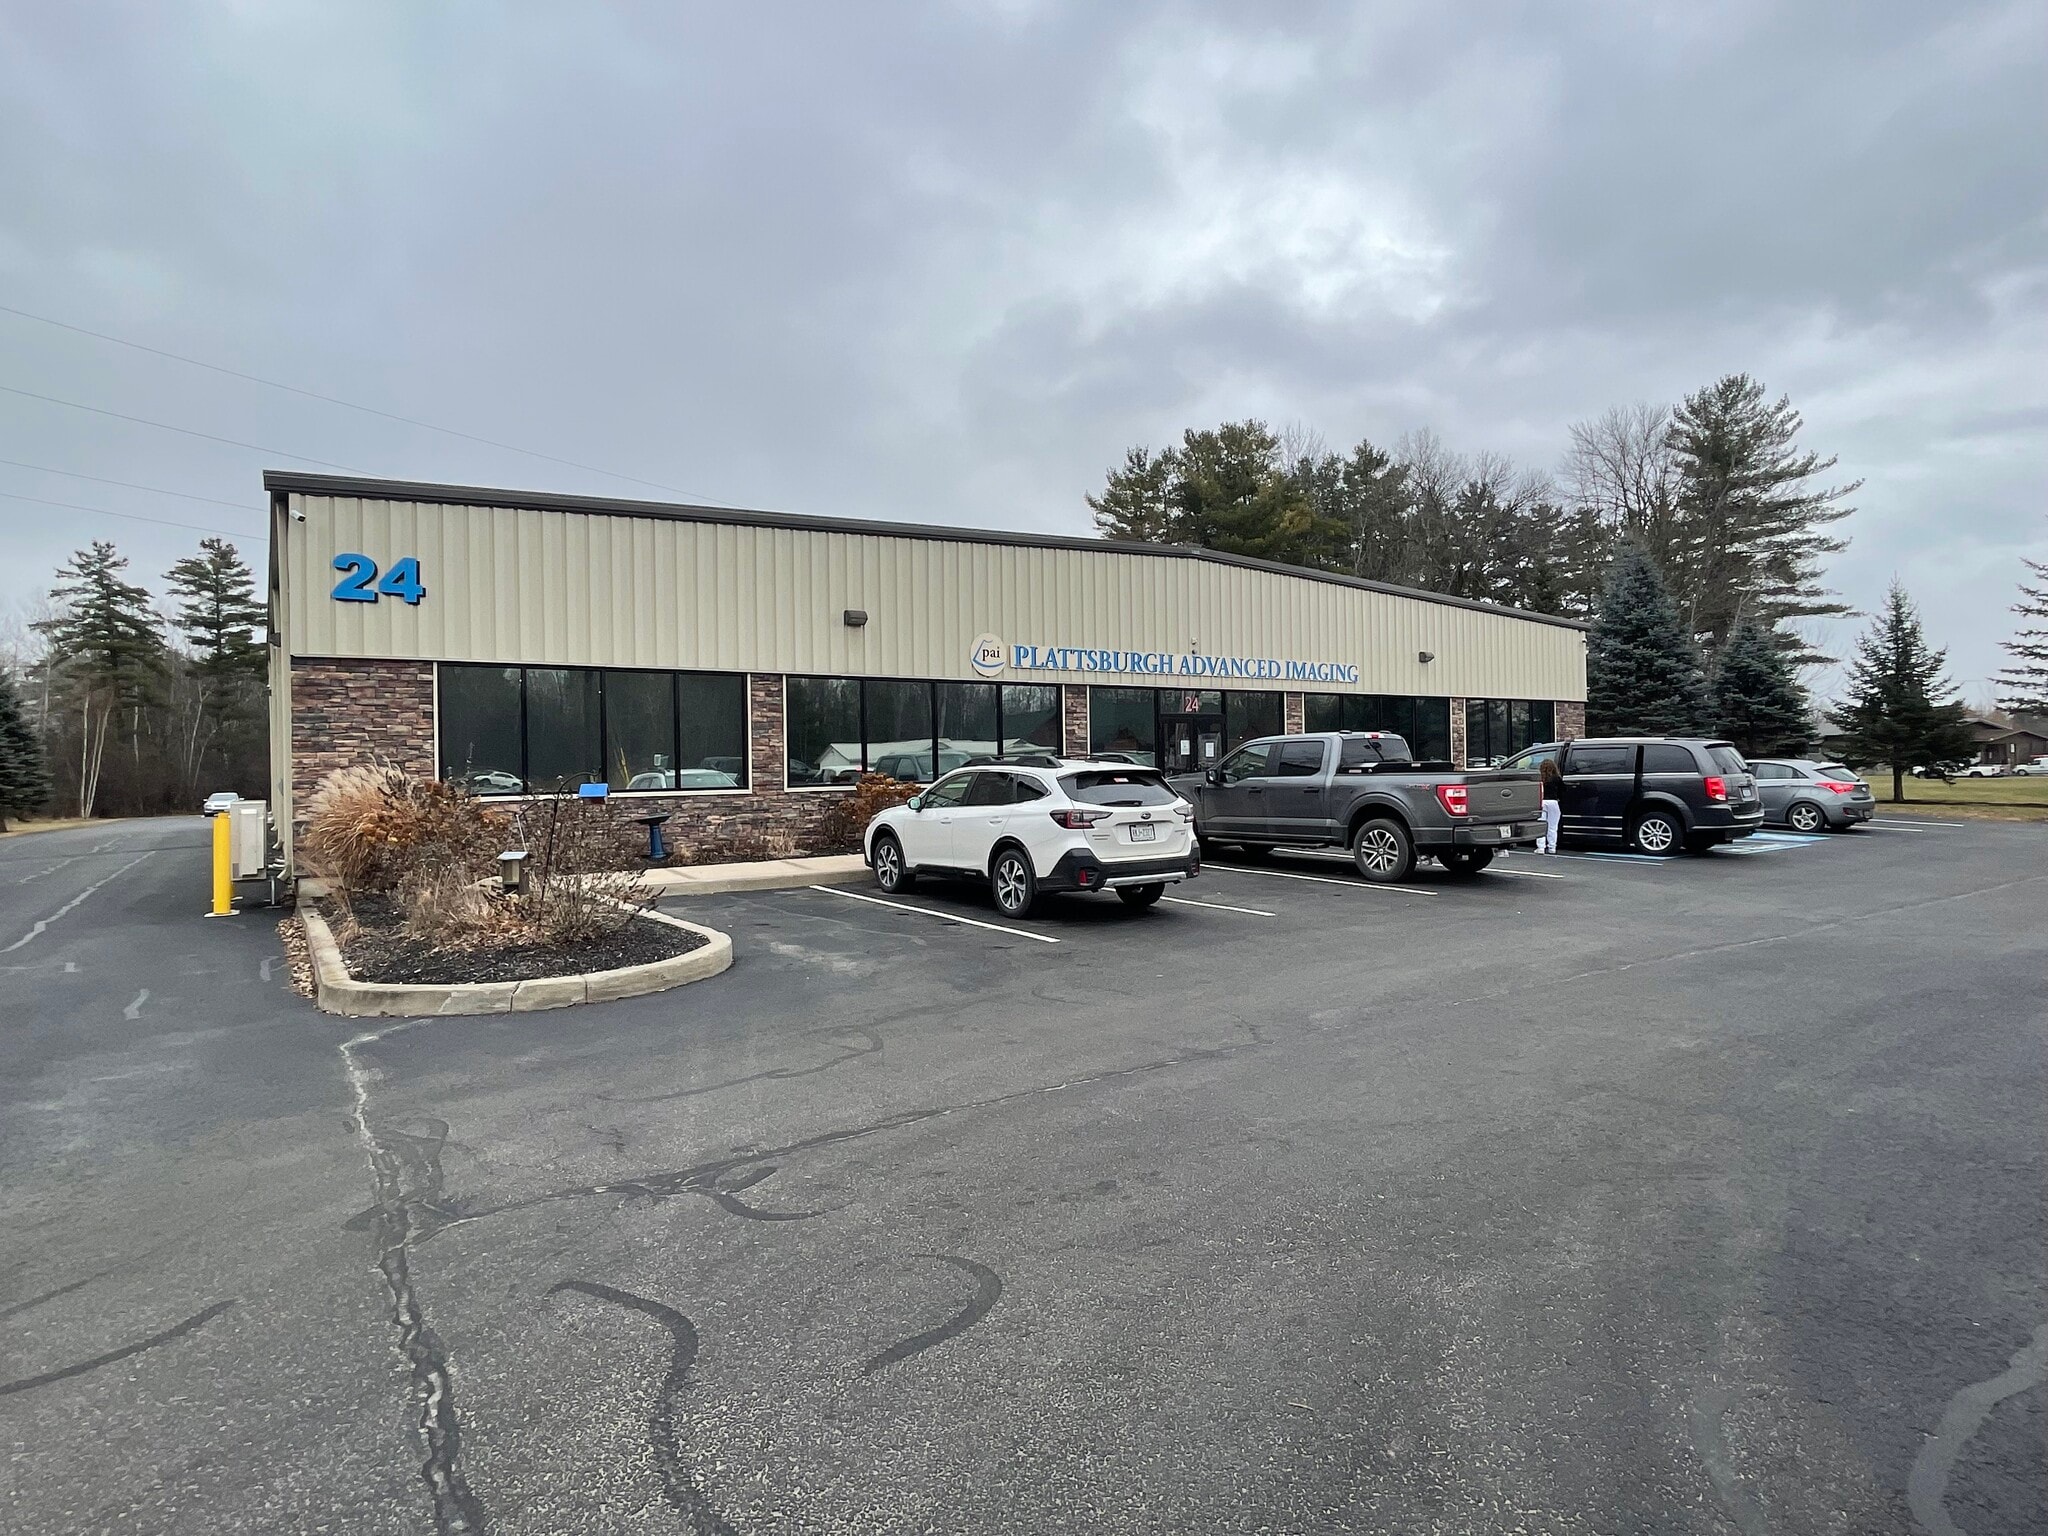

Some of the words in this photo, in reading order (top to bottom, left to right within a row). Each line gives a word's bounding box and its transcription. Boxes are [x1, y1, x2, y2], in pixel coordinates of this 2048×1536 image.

[331, 552, 426, 606] 24
[981, 647, 1001, 661] pai
[1013, 644, 1174, 674] PLATTSBURGH
[1179, 655, 1281, 680] ADVANCED
[1285, 661, 1359, 684] IMAGING
[1185, 696, 1200, 712] 24
